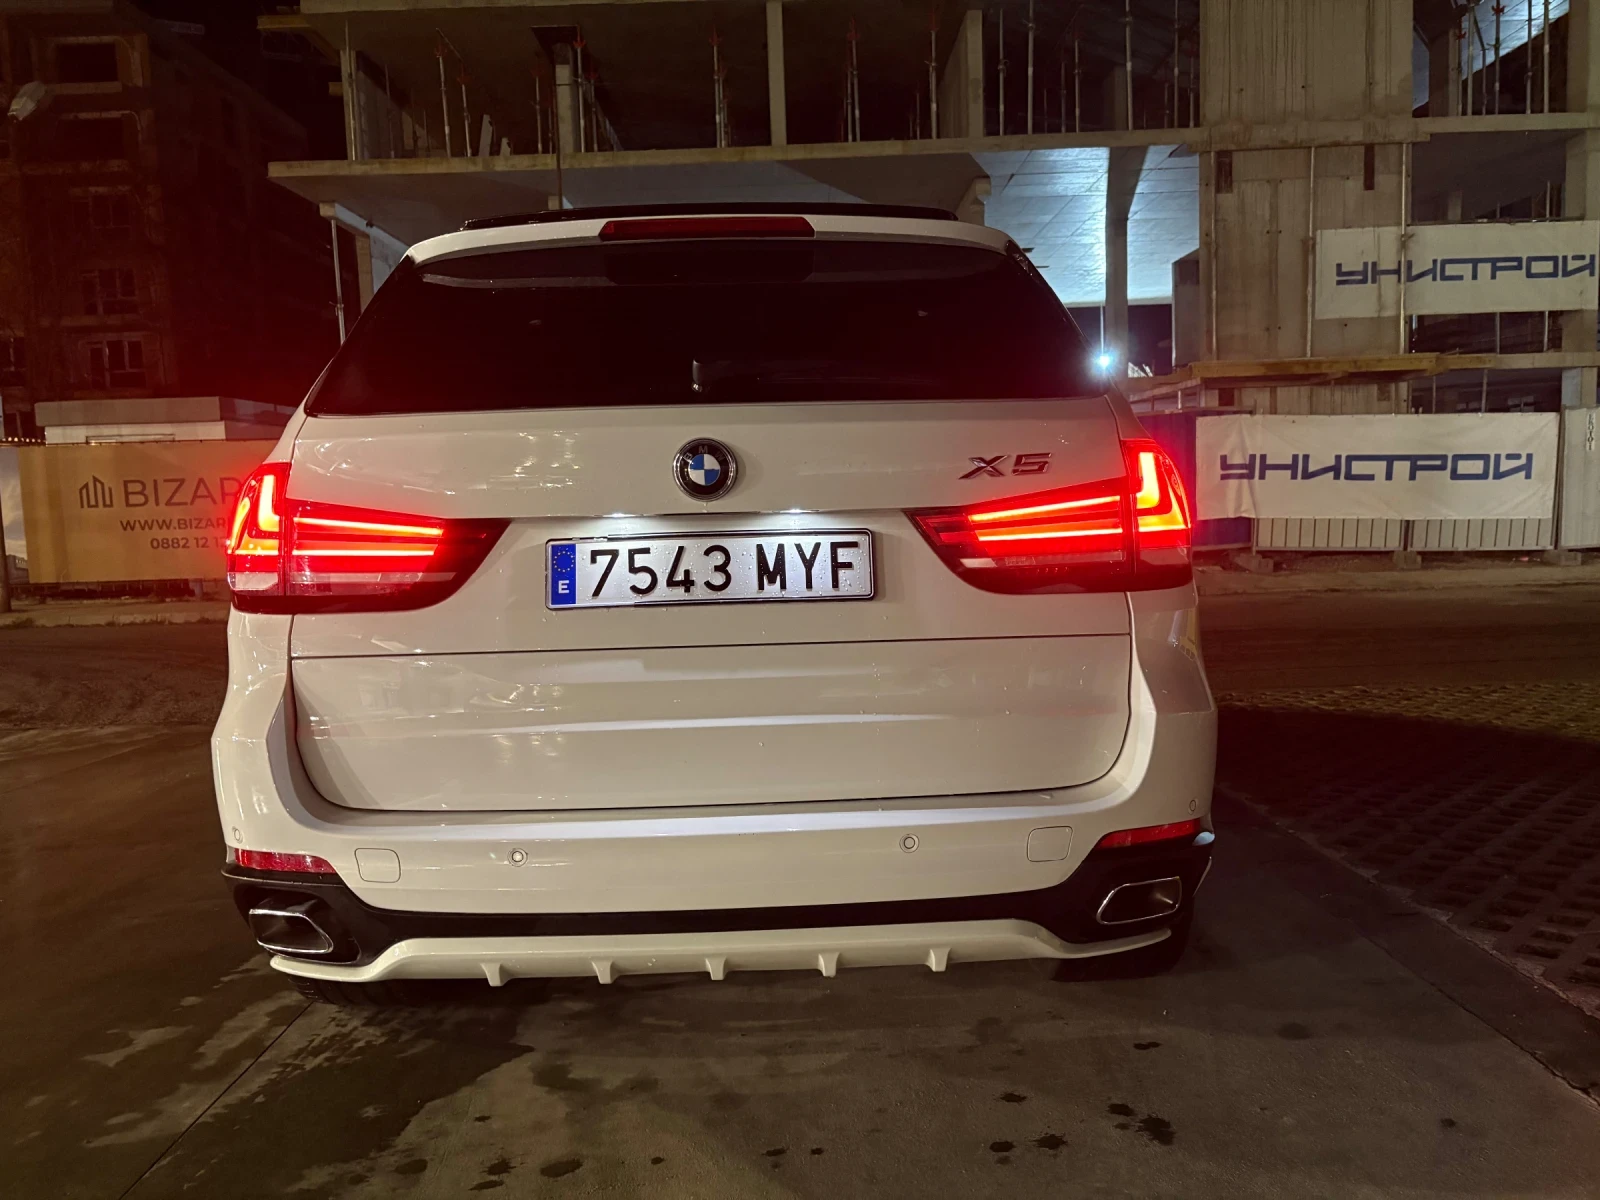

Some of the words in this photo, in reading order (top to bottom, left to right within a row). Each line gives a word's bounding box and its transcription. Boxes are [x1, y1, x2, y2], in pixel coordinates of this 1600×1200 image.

[1335, 254, 1596, 286] УНИСТРОЙ
[681, 445, 726, 463] BMW
[958, 452, 1052, 480] X5
[1219, 453, 1534, 482] УНИСТРОЙ
[150, 538, 190, 550] 0882
[194, 537, 210, 549] 12
[590, 544, 731, 598] 7543
[756, 541, 859, 591] MYF
[558, 580, 570, 594] E
